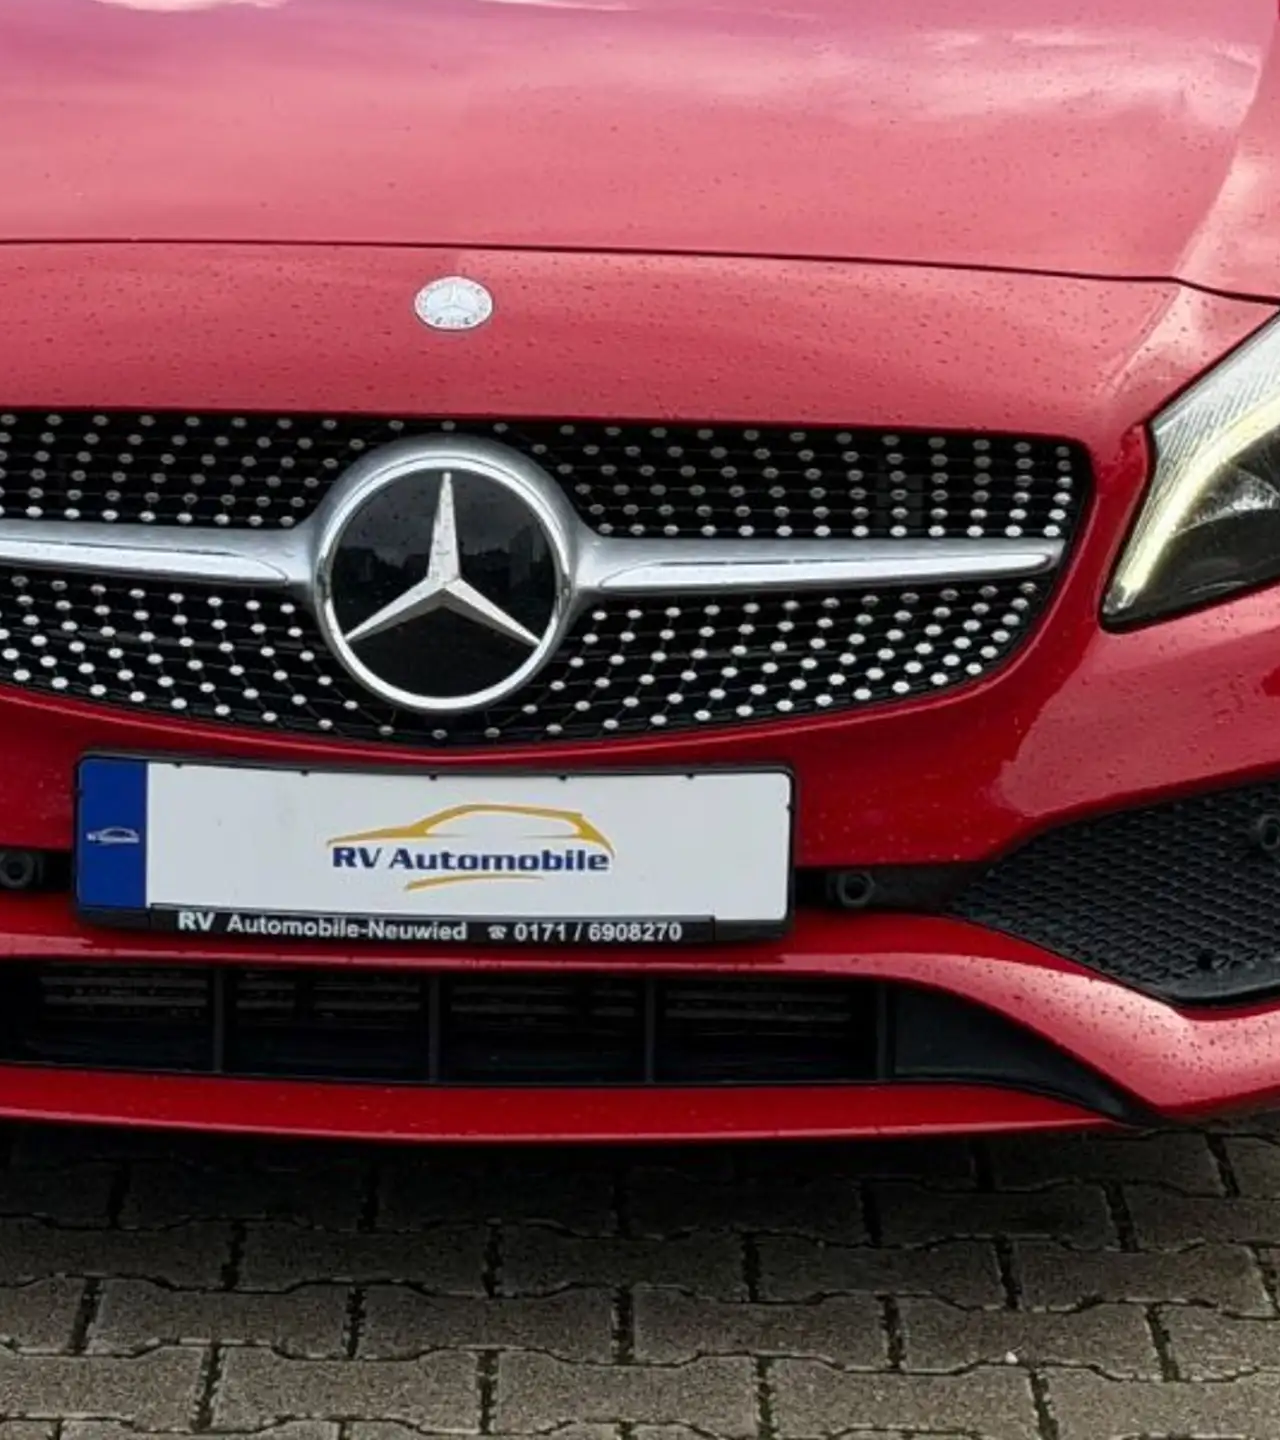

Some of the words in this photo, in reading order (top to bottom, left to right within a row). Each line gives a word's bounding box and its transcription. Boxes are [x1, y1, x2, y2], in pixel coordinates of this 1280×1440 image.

[332, 846, 382, 868] RV
[387, 848, 610, 871] Automobile
[178, 911, 214, 932] RV
[227, 914, 467, 941] Automobile-Neuwied
[514, 922, 566, 942] 0171
[588, 922, 683, 942] 6908270
